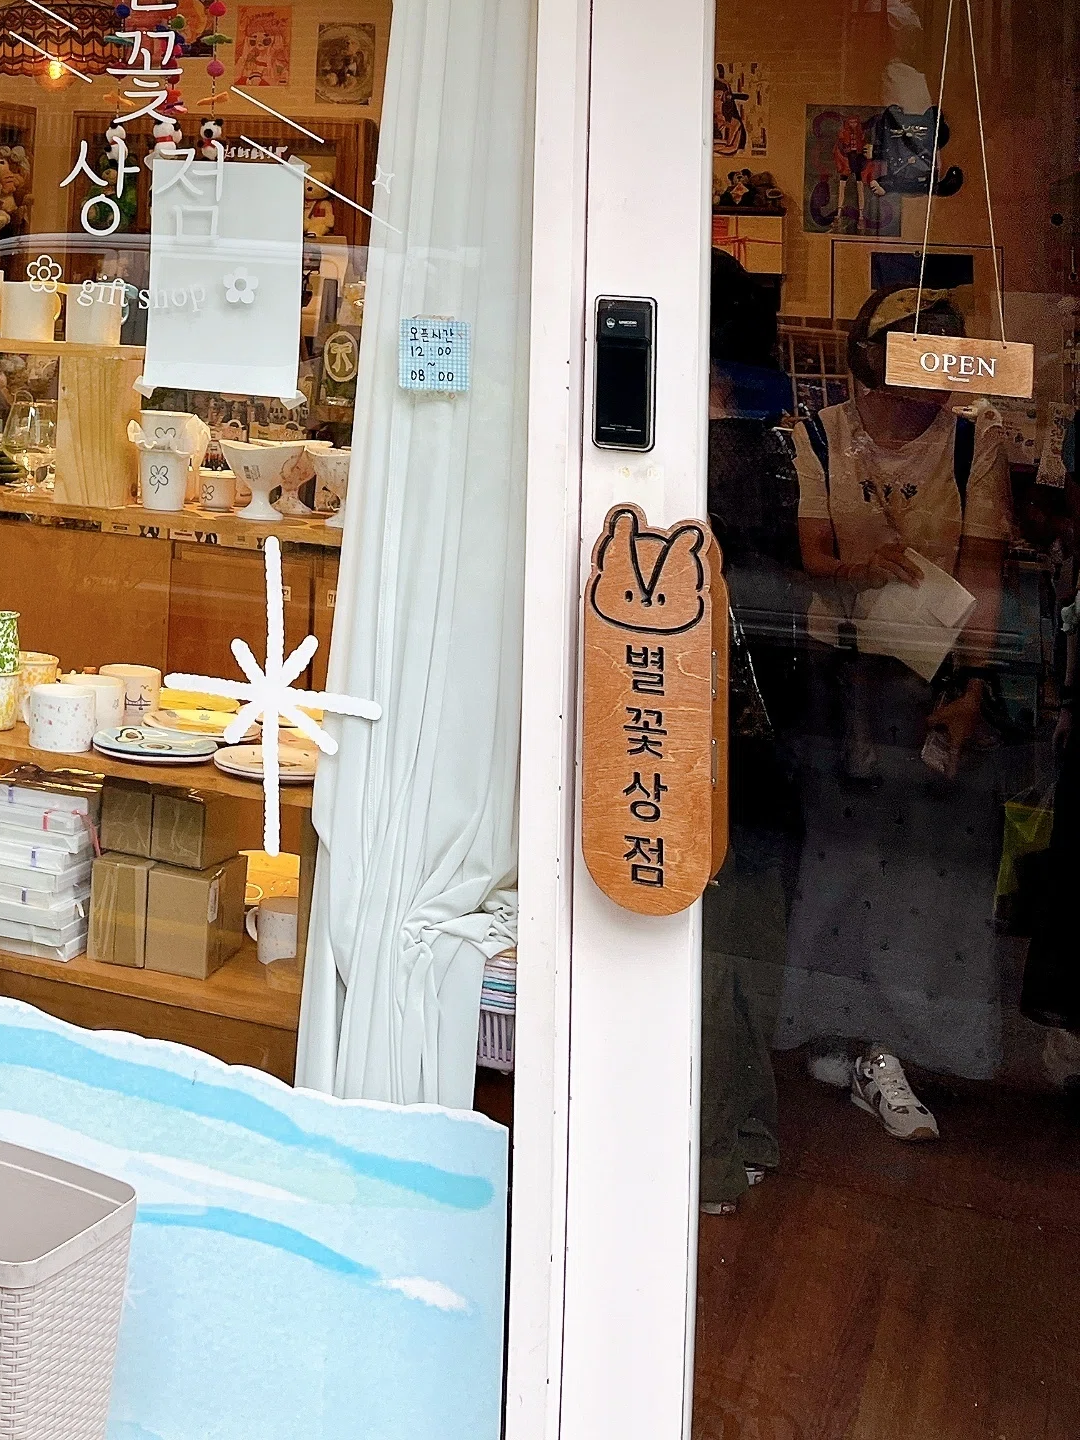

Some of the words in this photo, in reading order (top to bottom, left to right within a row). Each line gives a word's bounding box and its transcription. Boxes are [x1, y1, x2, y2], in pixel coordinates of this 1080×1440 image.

[76, 275, 130, 309] gift
[138, 282, 208, 313] shop
[920, 352, 997, 378] OPEN
[623, 643, 669, 888] 별꽃상점
